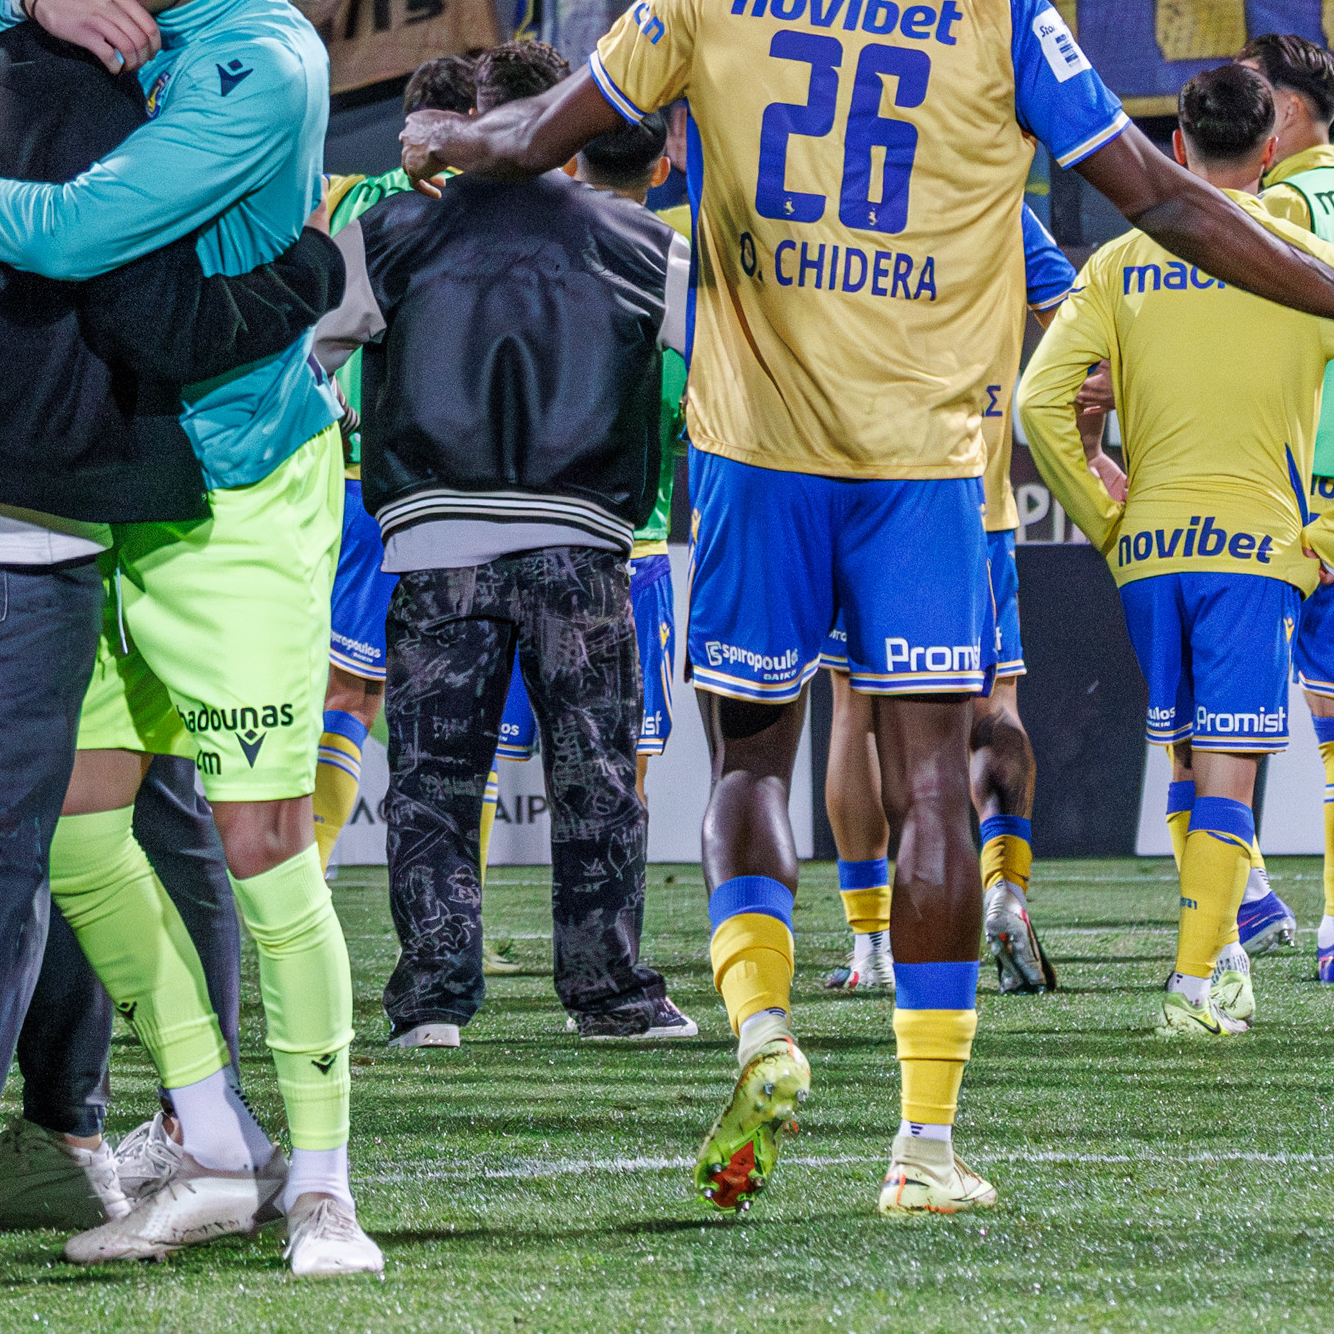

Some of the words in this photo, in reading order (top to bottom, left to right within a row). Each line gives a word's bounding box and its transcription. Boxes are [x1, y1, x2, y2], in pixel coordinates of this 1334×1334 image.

[755, 29, 932, 234] 26
[774, 239, 937, 302] CHIDERA
[1118, 516, 1274, 567] novibet
[1196, 705, 1289, 734] Promist
